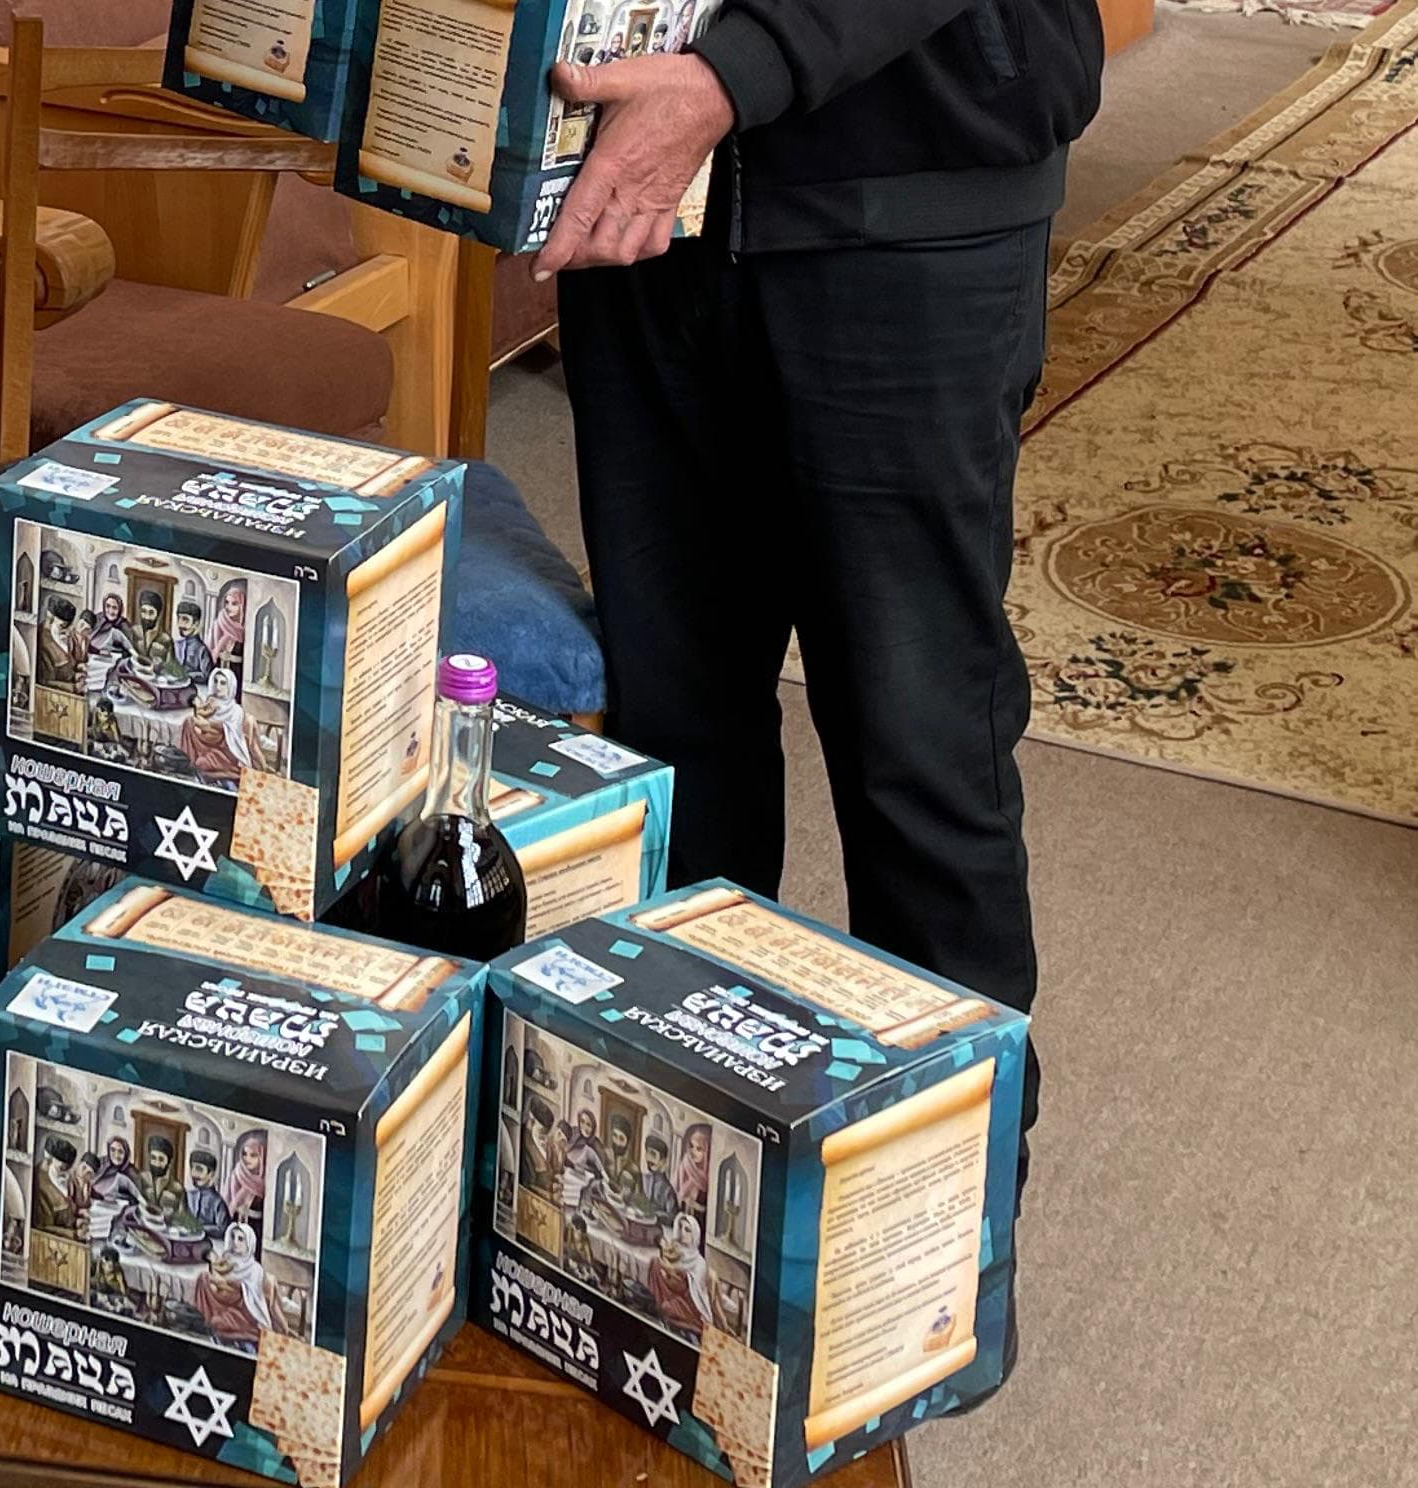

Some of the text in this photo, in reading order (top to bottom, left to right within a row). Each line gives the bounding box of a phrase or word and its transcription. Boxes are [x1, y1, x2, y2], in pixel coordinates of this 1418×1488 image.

[3, 772, 129, 842] МАЦА
[138, 1020, 329, 1081] ИЗРАИЛЬСКАЯ
[624, 1006, 786, 1092] ИЗРАИЛЬСКАЯ
[489, 1267, 599, 1370] МАЦА
